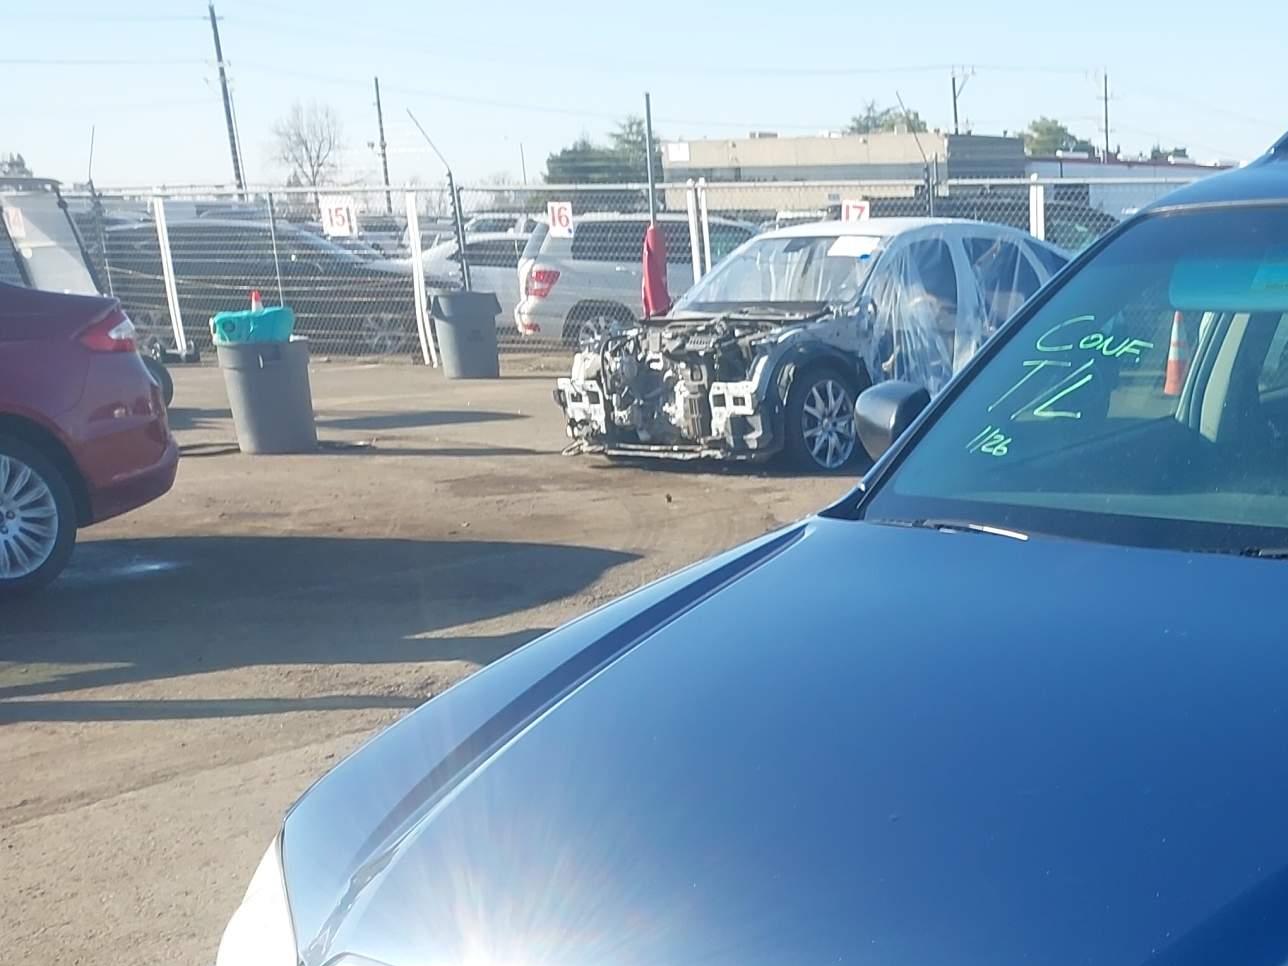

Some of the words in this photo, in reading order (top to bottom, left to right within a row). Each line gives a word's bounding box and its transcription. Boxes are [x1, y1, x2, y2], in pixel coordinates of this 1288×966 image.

[327, 207, 346, 227] 15
[550, 206, 570, 227] 16
[844, 205, 866, 222] 17
